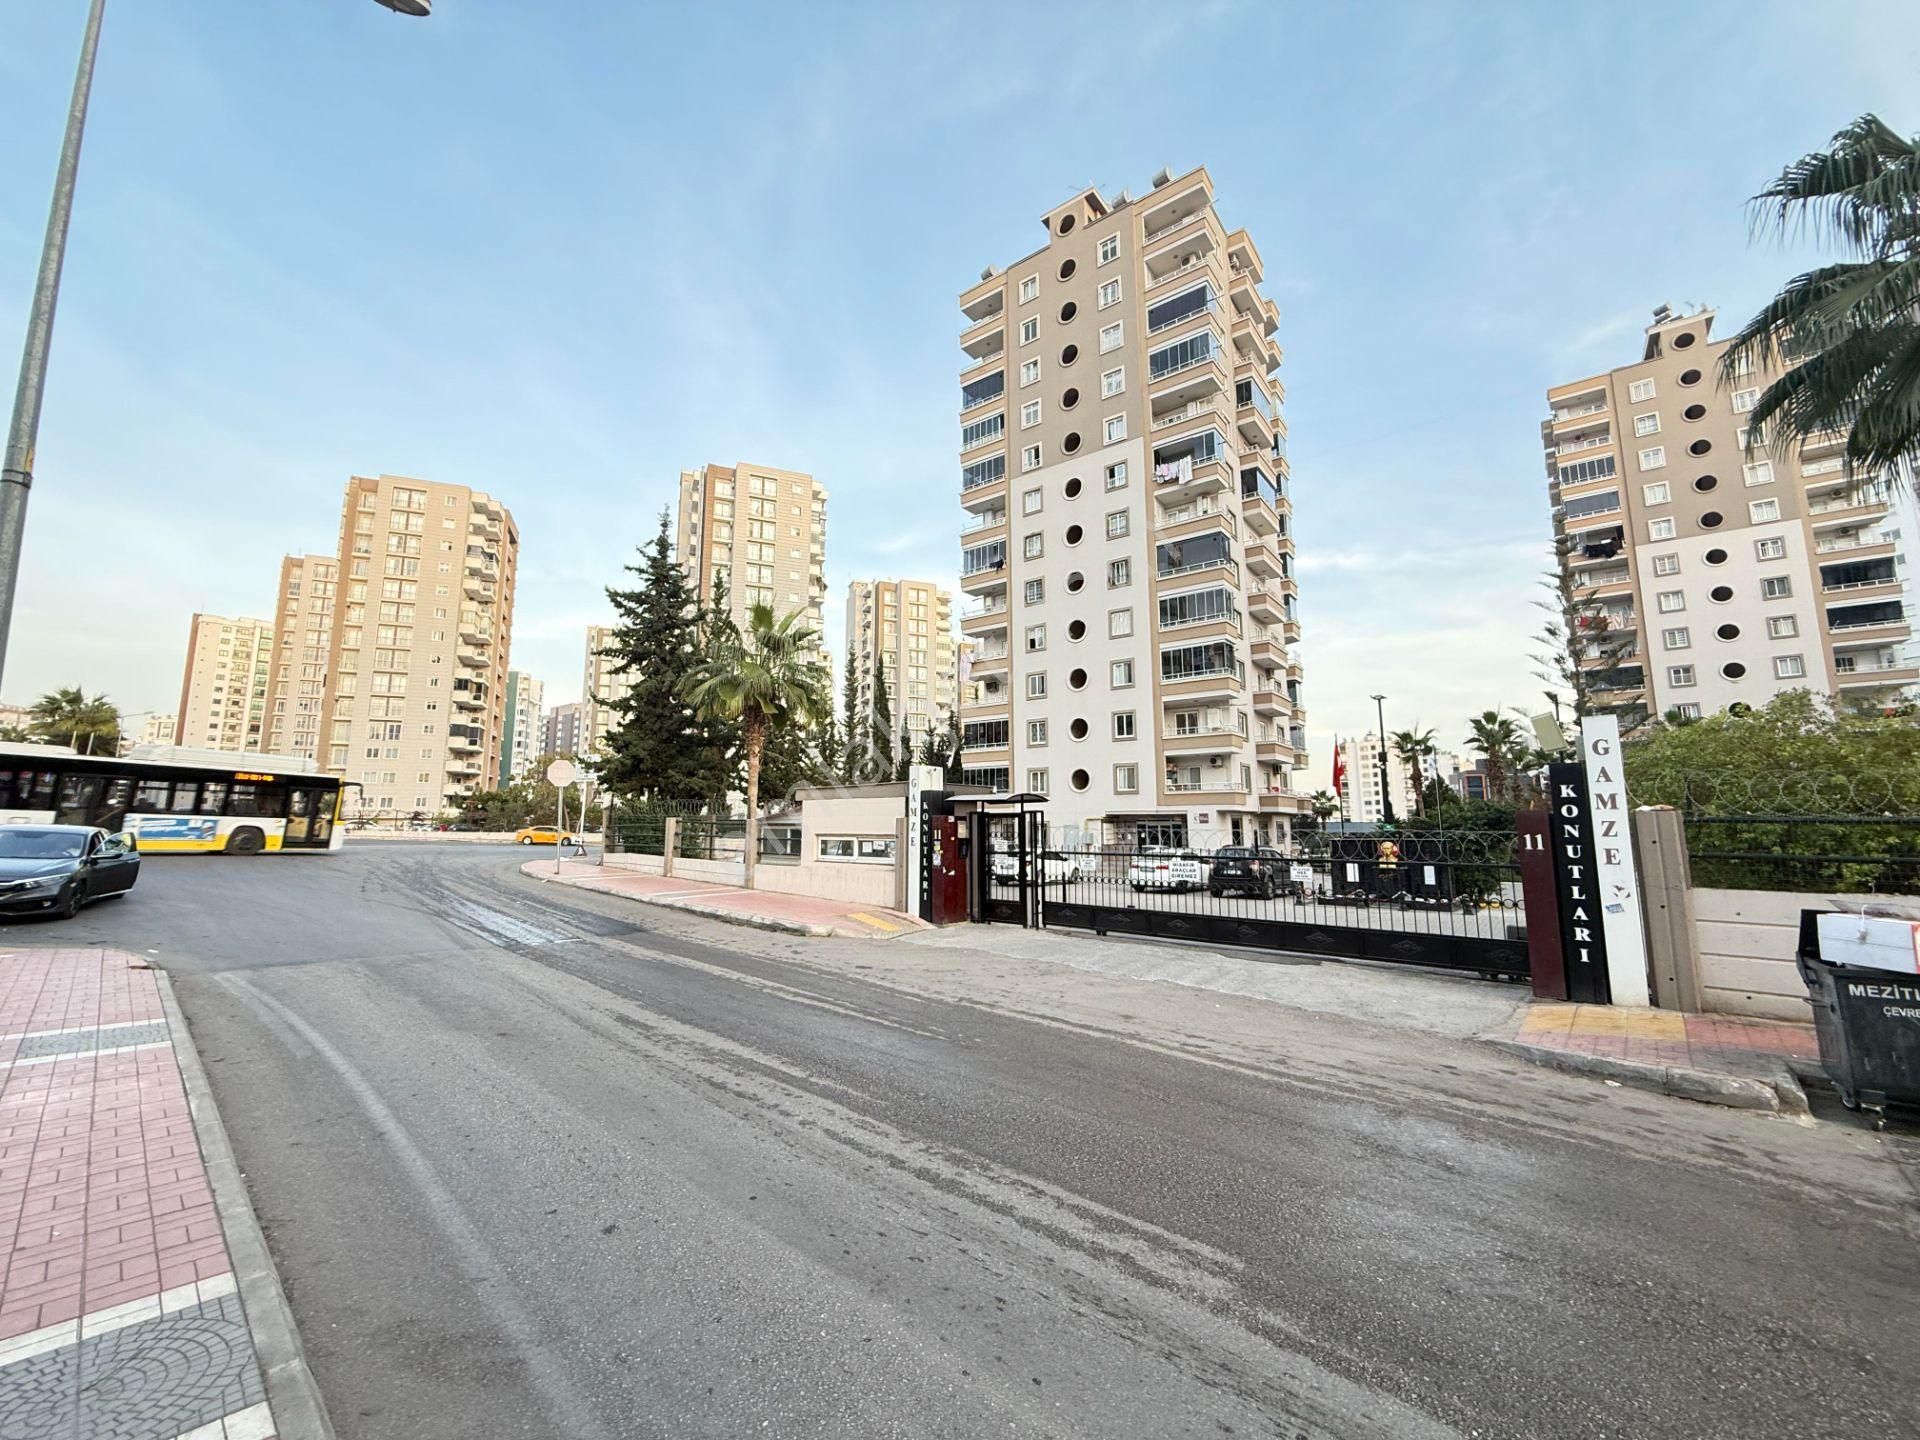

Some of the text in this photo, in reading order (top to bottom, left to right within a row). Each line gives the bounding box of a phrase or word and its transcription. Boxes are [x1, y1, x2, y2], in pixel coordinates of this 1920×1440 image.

[910, 778, 918, 847] GAMZE
[934, 829, 941, 840] 11
[1592, 738, 1621, 866] GAMZE
[1523, 833, 1545, 851] 11
[1559, 784, 1593, 963] KONUTLARI
